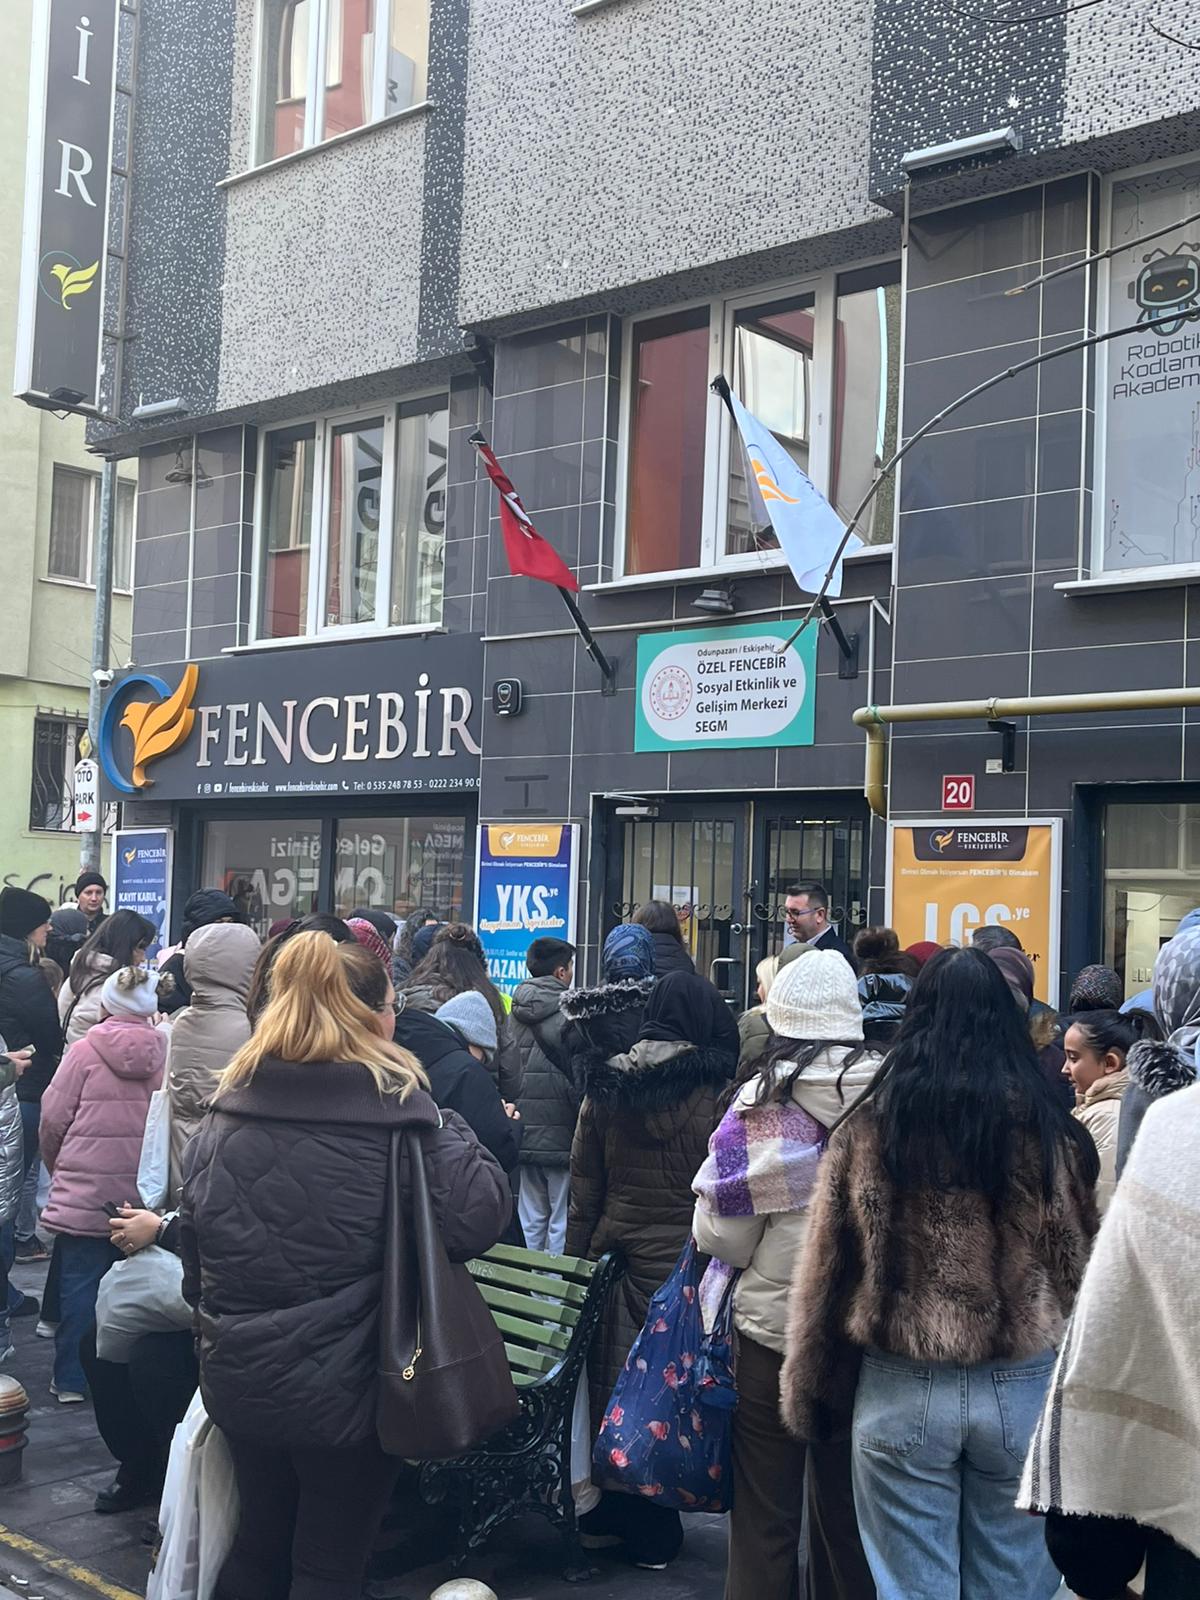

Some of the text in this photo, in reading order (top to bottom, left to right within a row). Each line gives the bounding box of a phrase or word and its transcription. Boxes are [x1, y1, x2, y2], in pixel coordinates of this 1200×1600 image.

[697, 646, 738, 658] Odunpazarı
[743, 643, 776, 653] Eskişehir
[697, 655, 787, 675] ÖZEL FENCEBİR
[696, 677, 797, 696] Sosyal Etkinlik ve
[696, 696, 788, 716] Gelişim Merkezi
[196, 672, 481, 767] FENCEBİR
[695, 720, 728, 733] SEGM
[77, 769, 92, 783] OTO
[353, 781, 366, 791] Tel:
[366, 781, 372, 790] 0
[373, 780, 387, 790] 535
[387, 780, 401, 790] 248
[402, 780, 412, 789] 78
[413, 779, 423, 789] 53
[428, 778, 447, 788] 0222
[448, 778, 463, 788] 234
[465, 778, 475, 787] 90
[75, 791, 94, 806] PARK
[946, 781, 971, 804] 20
[957, 831, 1010, 843] FENCEBİR
